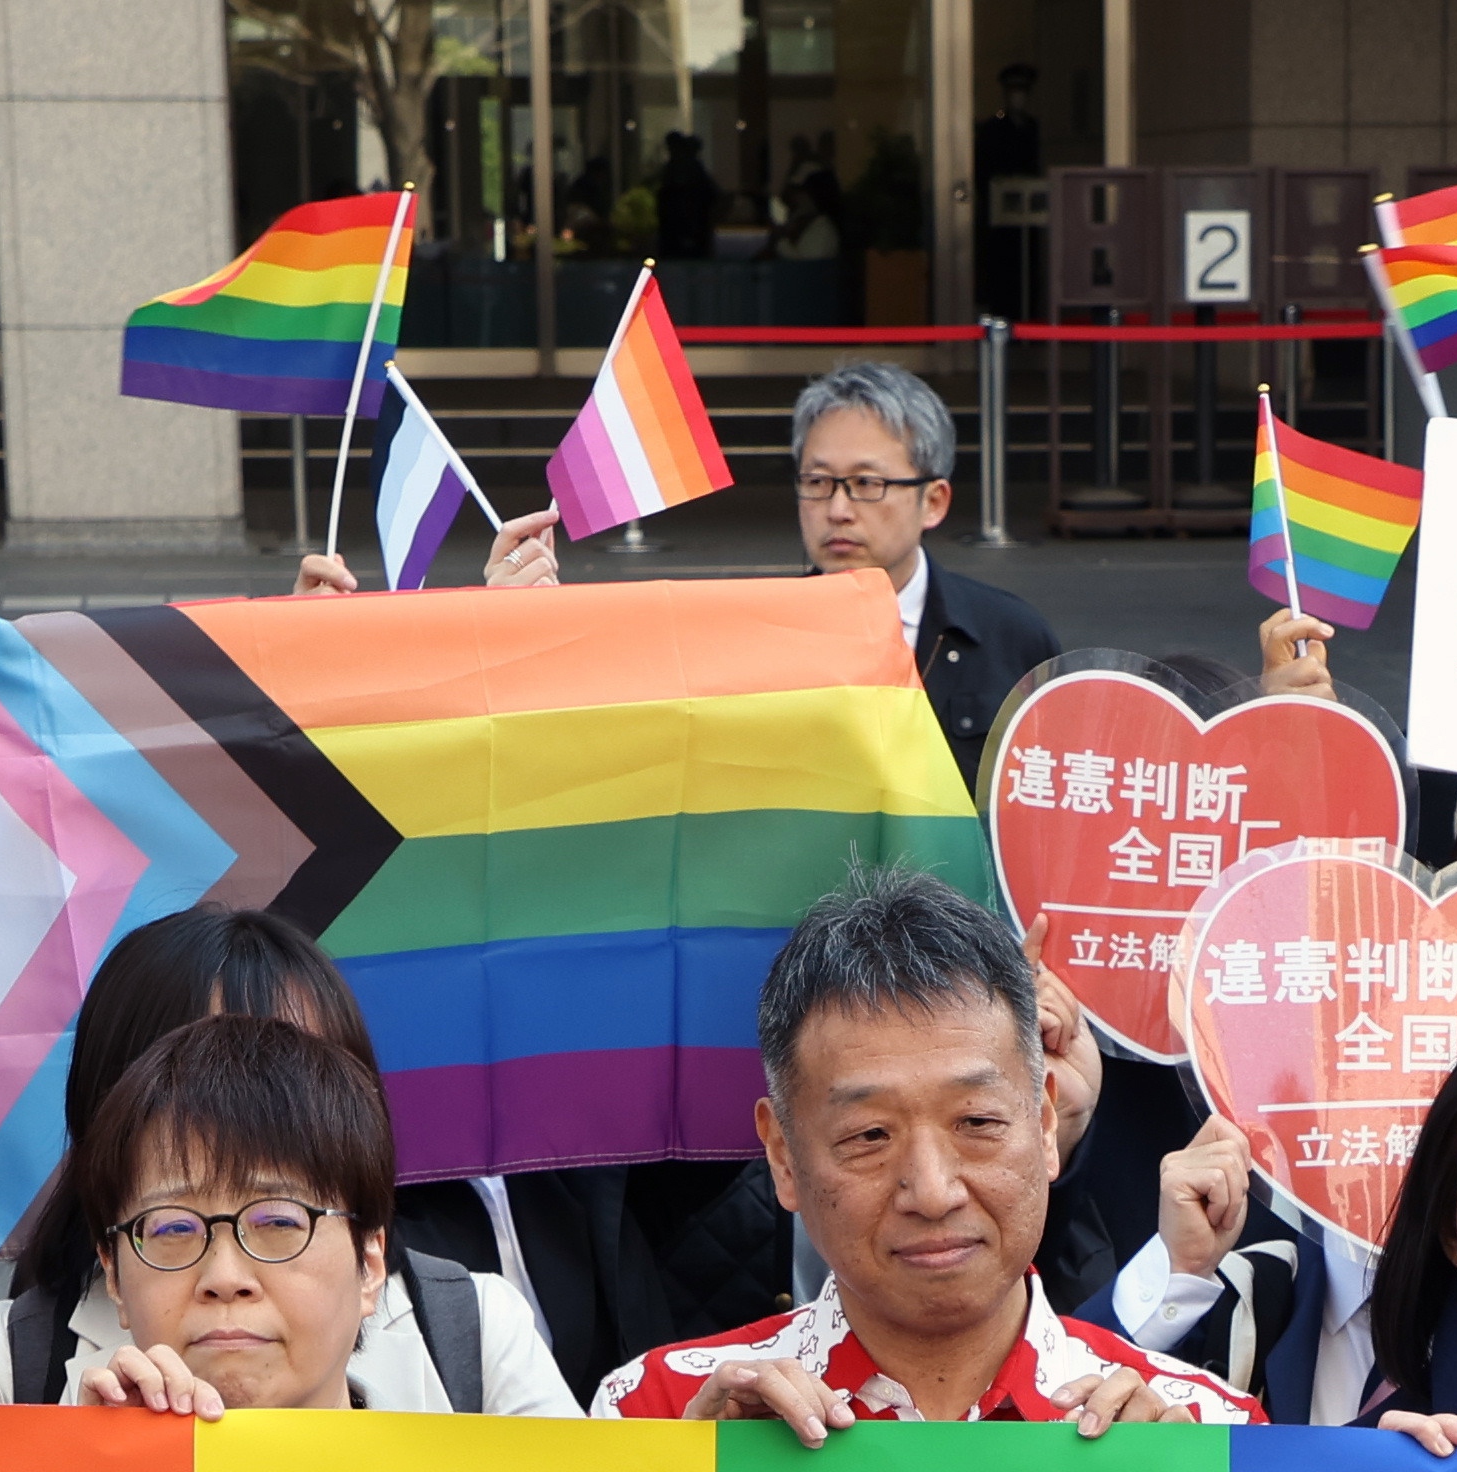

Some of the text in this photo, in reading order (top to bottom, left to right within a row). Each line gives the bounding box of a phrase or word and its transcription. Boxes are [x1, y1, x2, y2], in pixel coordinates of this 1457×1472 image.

[1198, 224, 1239, 290] 2
[1007, 745, 1248, 824] 違憲判断
